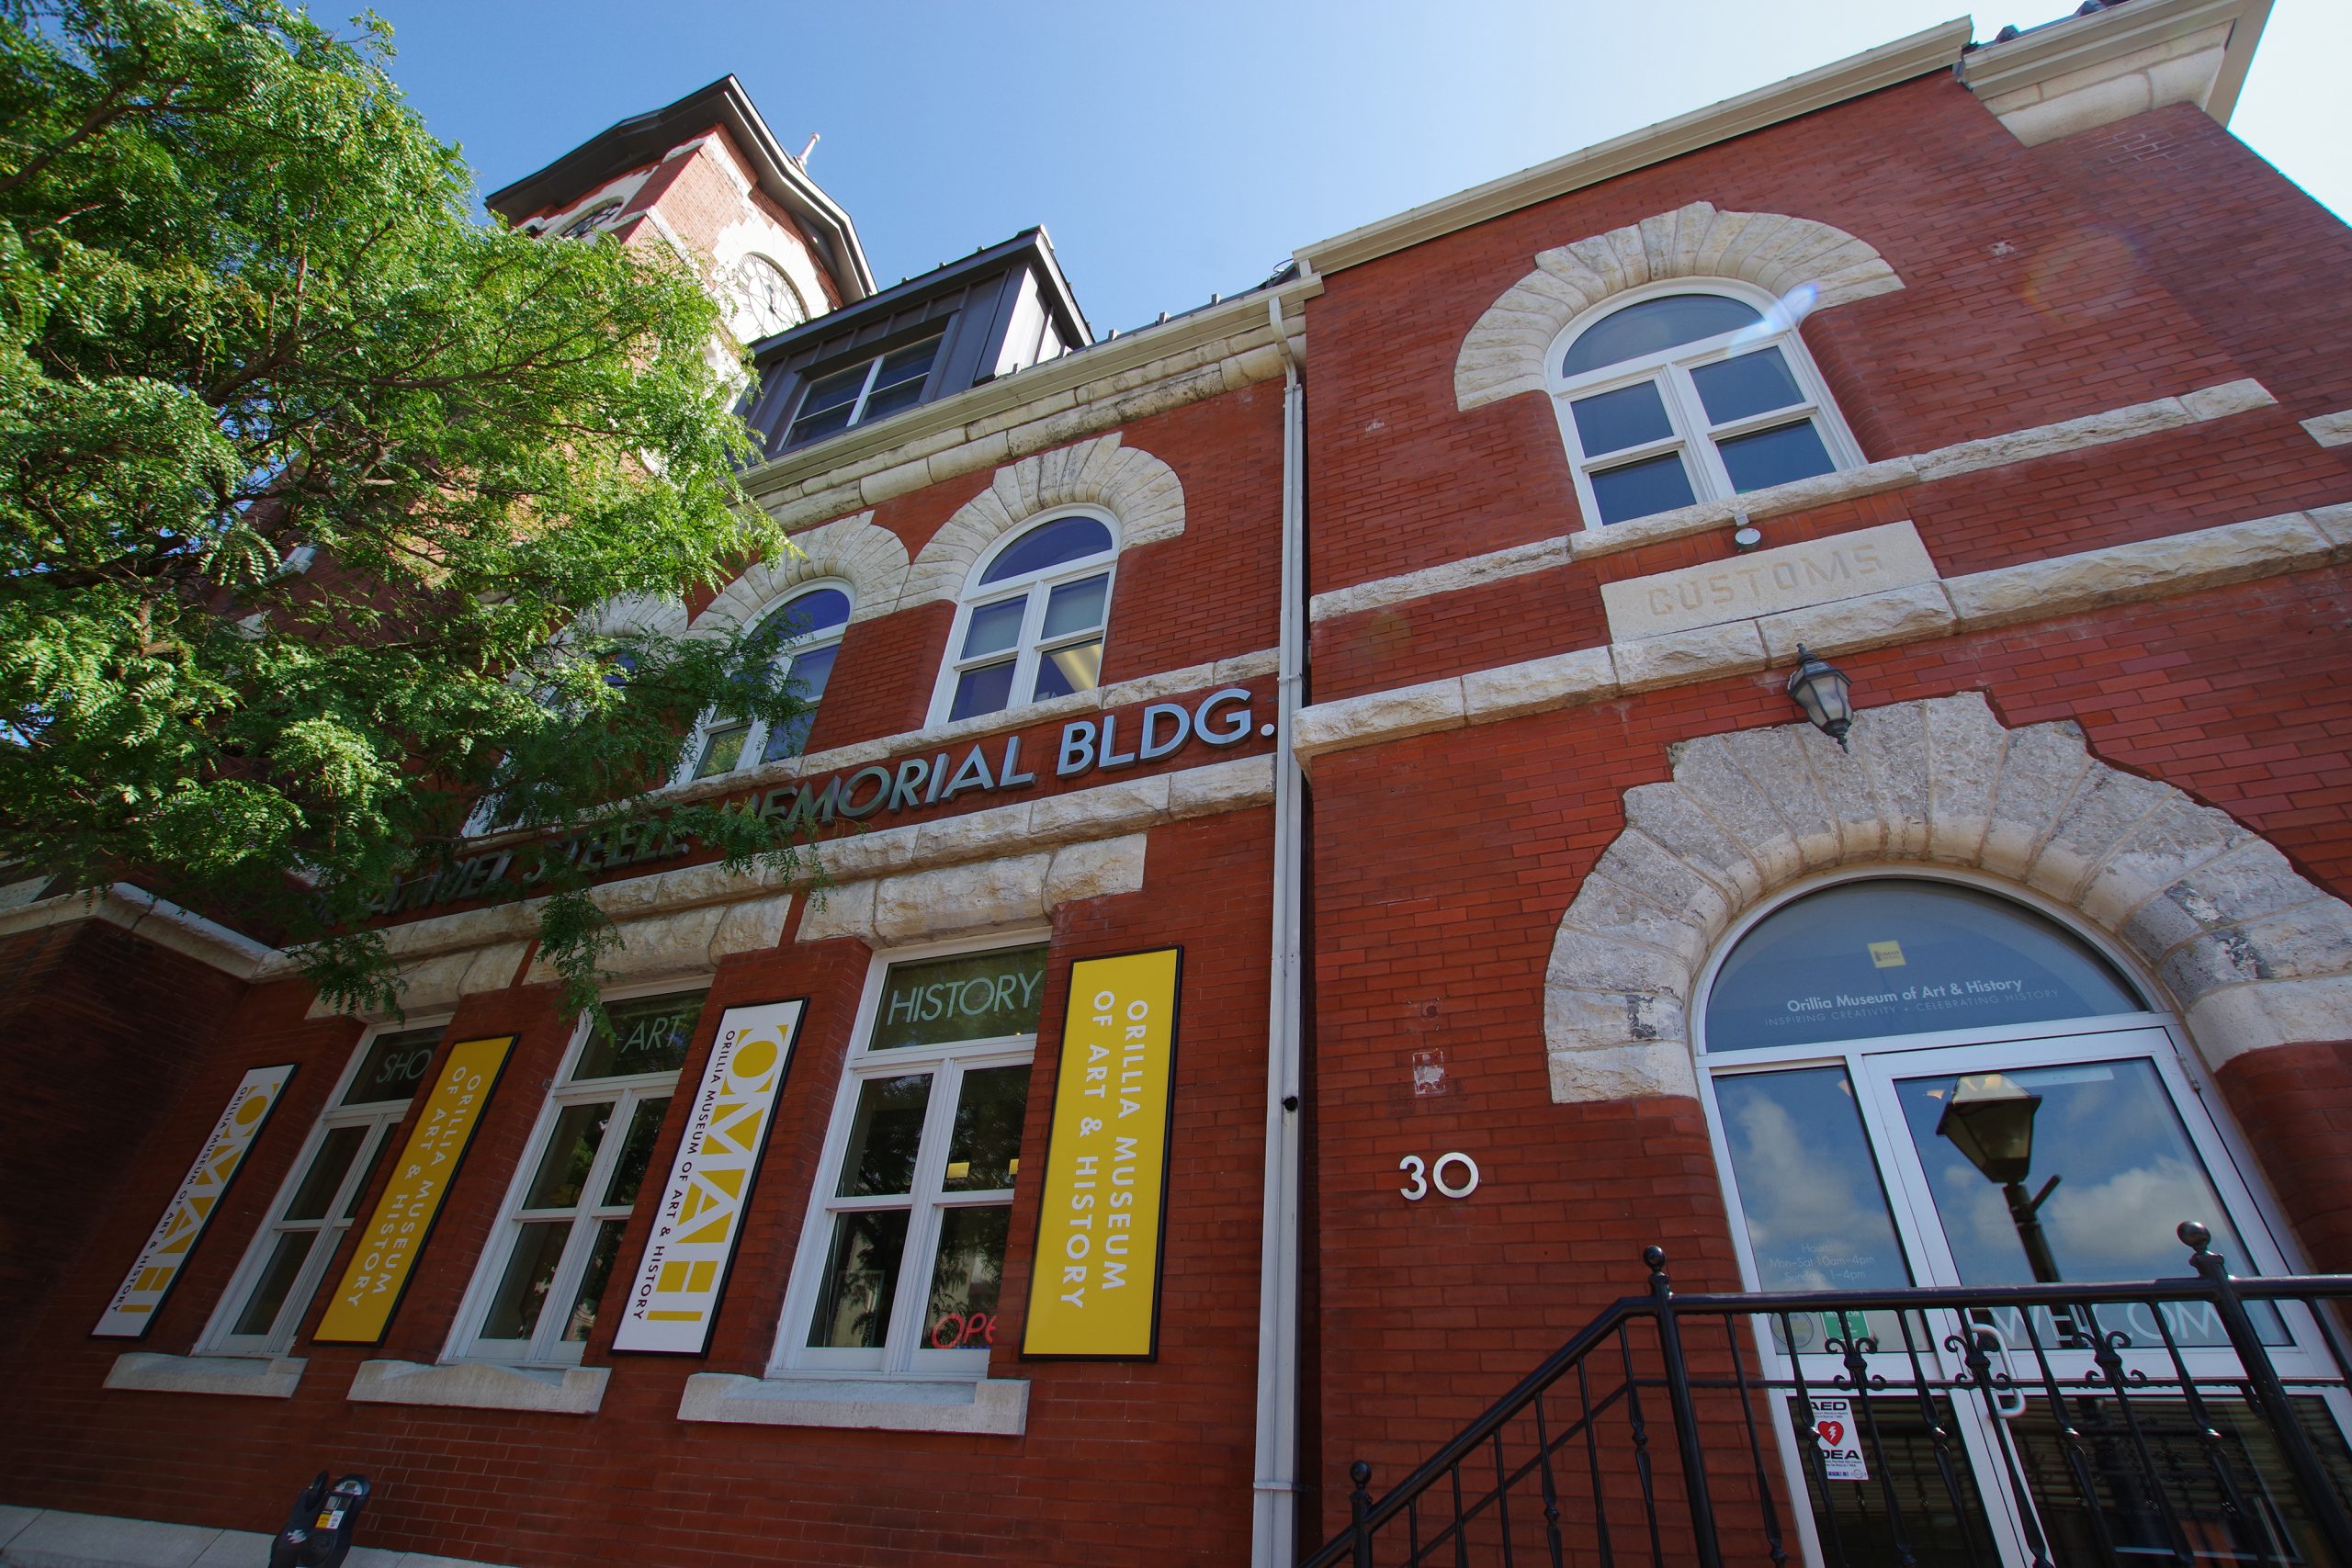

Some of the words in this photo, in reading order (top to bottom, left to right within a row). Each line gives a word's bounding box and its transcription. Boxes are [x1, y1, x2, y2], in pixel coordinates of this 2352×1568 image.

[1648, 543, 1883, 617] CUSTOMS
[1056, 688, 1276, 780] BLDG.
[887, 970, 1045, 1026] HISTORY
[1092, 990, 1115, 1027] OF
[1764, 1013, 1826, 1027] INSPIRING
[1831, 1006, 1896, 1021] CREATIVITY
[1916, 995, 2000, 1012] CELEBRATING
[2005, 988, 2059, 1002] HISTORY
[1787, 996, 1833, 1012] Orillia
[1837, 991, 1898, 1008] Museum
[1902, 986, 1917, 1000] of
[1922, 985, 1946, 998] Art
[1950, 982, 1964, 996] &
[1966, 979, 2022, 993] History
[620, 1014, 688, 1054] ART
[710, 1030, 736, 1084] ORILLIA
[447, 1066, 467, 1095] OF
[1084, 1043, 1110, 1099] ART
[1117, 999, 1149, 1119] ORILLIA
[219, 1087, 248, 1130] ORILLIA
[420, 1108, 447, 1151] ART
[430, 1074, 481, 1166] ORILLIA
[686, 1090, 717, 1155] MUSEUM
[1080, 1117, 1102, 1137] &
[187, 1134, 221, 1185] MUSEUM
[404, 1164, 422, 1179] &
[679, 1161, 693, 1182] OF
[1399, 1152, 1479, 1201] 30
[175, 1190, 187, 1205] OF
[666, 1189, 684, 1219] ART
[1102, 1136, 1138, 1290] MUSEUM
[149, 1240, 158, 1249] &
[158, 1213, 175, 1234] ART
[371, 1179, 435, 1294] MUSEUM
[659, 1226, 672, 1237] &
[1060, 1156, 1099, 1309] HISTORY
[347, 1193, 409, 1307] HISTORY
[112, 1255, 150, 1313] HISTORY
[633, 1246, 665, 1320] HISTORY
